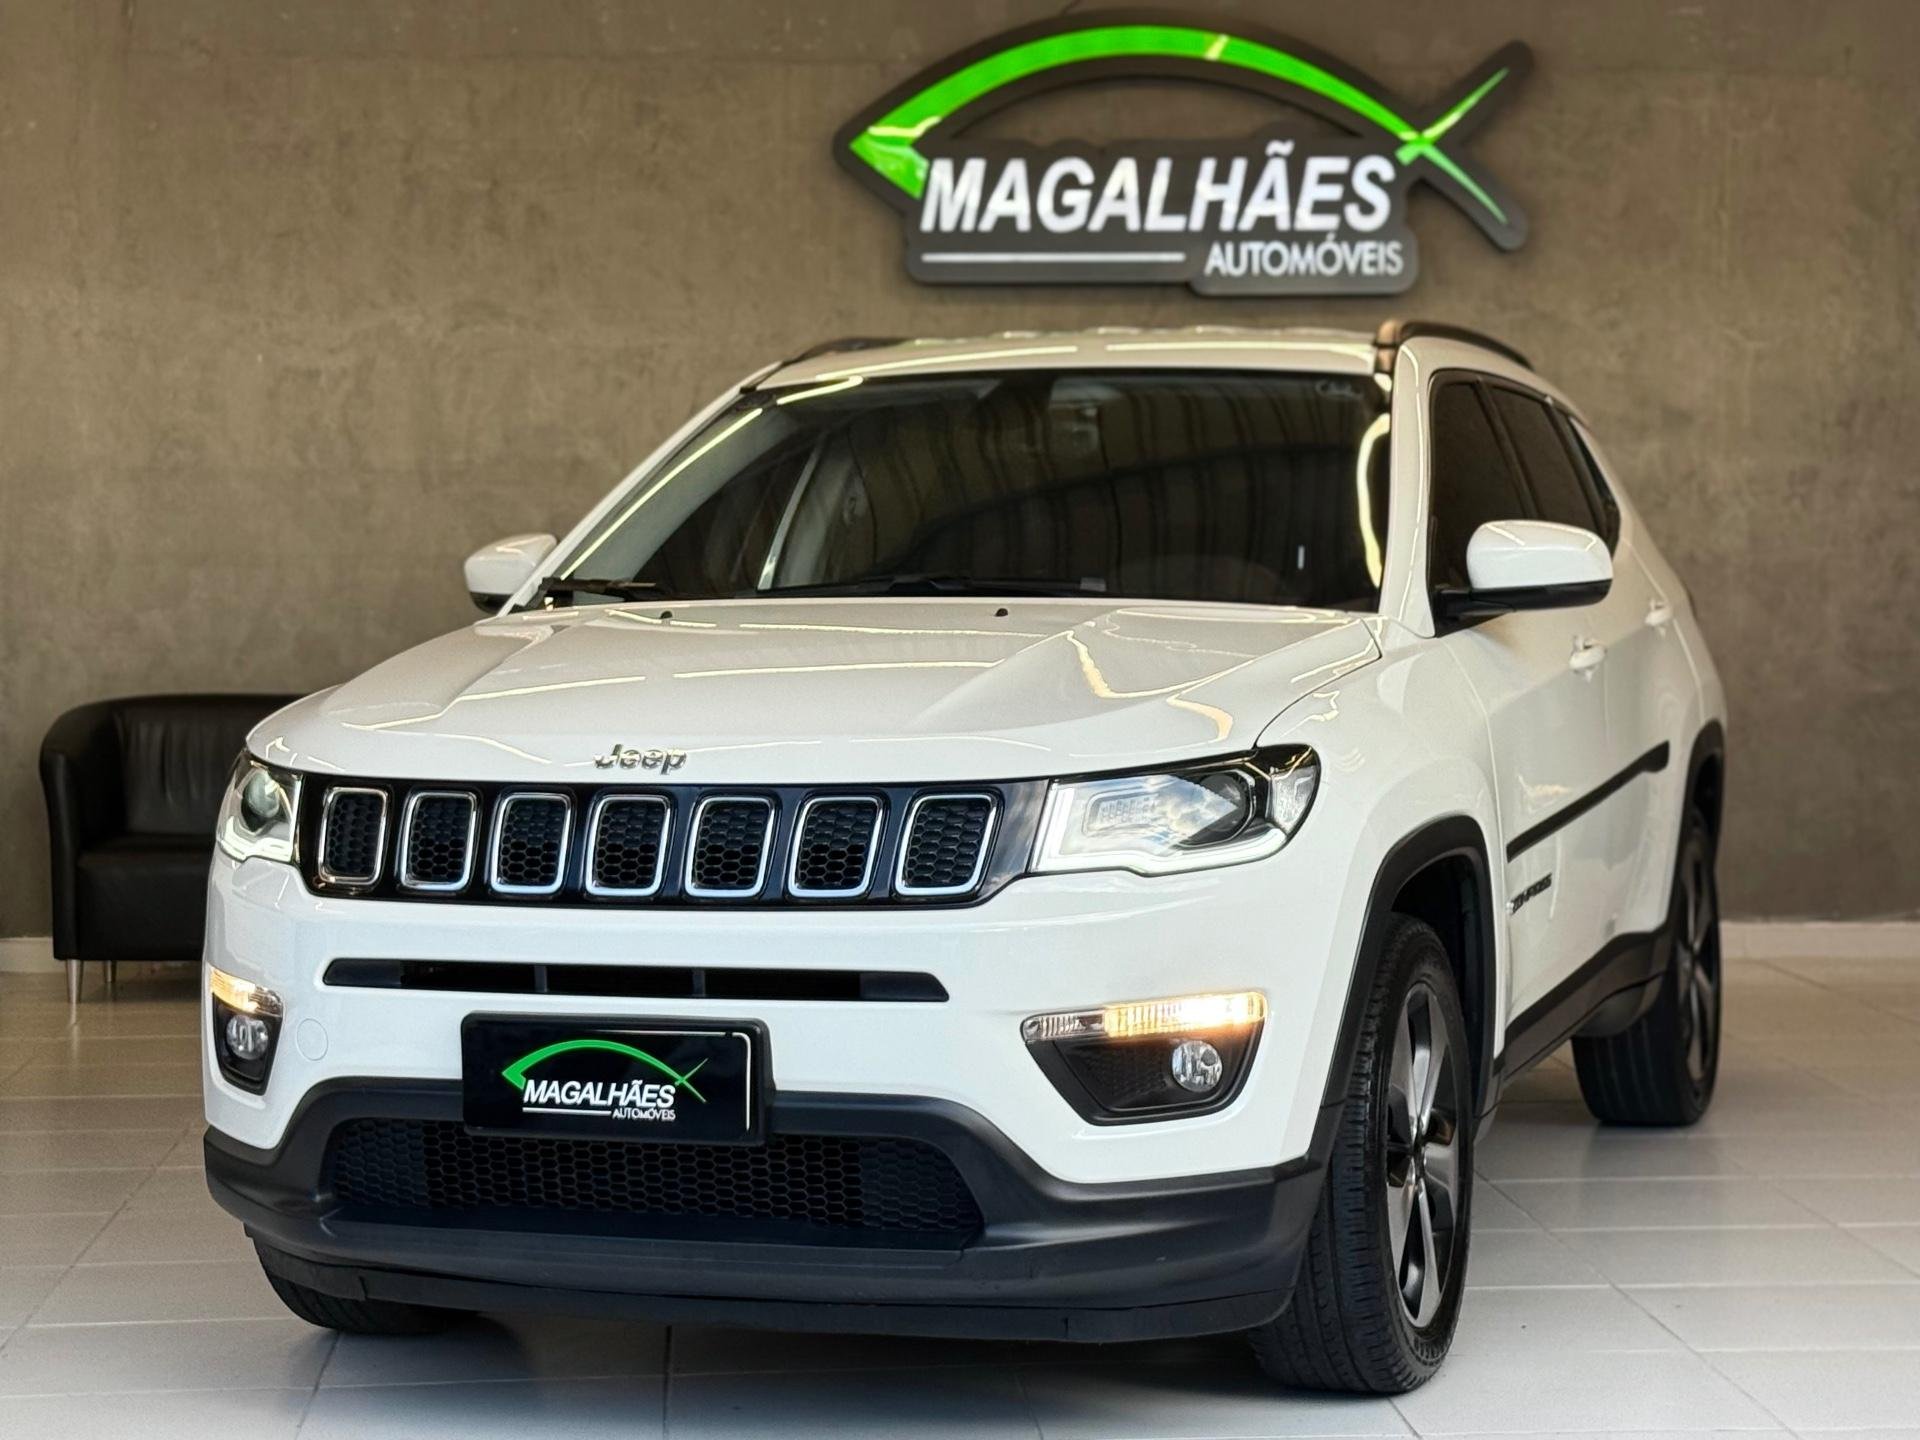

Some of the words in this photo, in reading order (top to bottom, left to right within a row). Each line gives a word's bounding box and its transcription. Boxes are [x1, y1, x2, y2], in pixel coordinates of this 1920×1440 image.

[920, 140, 1396, 233] MAGALHÃES
[1204, 233, 1403, 277] AUTOMÓVEIS
[594, 744, 686, 775] Jeep
[522, 1079, 676, 1108] MAGALHÃES
[612, 1107, 676, 1121] AUTOMÓVEIS
